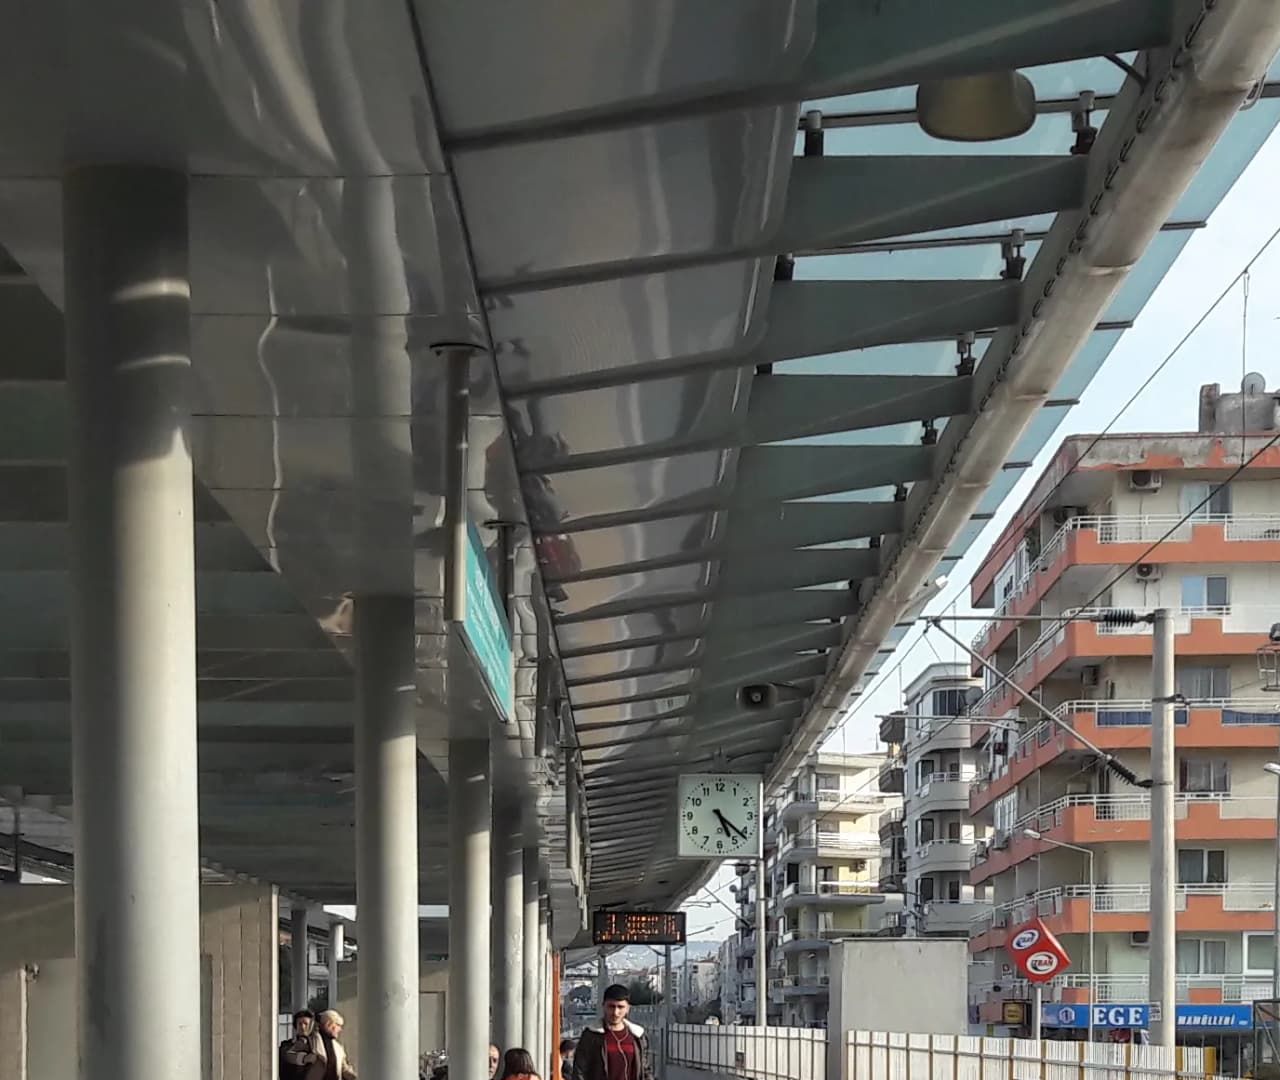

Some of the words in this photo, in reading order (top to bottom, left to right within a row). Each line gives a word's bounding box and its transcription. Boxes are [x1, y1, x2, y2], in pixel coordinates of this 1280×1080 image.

[703, 787, 710, 796] 11
[715, 783, 726, 792] 12
[692, 798, 702, 807] 10
[742, 798, 750, 806] 2
[687, 812, 693, 821] 9
[747, 812, 753, 820] 3
[692, 826, 698, 835] 8
[703, 836, 710, 845] 7
[717, 840, 723, 849] 6
[732, 835, 738, 845] 5
[1093, 1007, 1143, 1026] EGE
